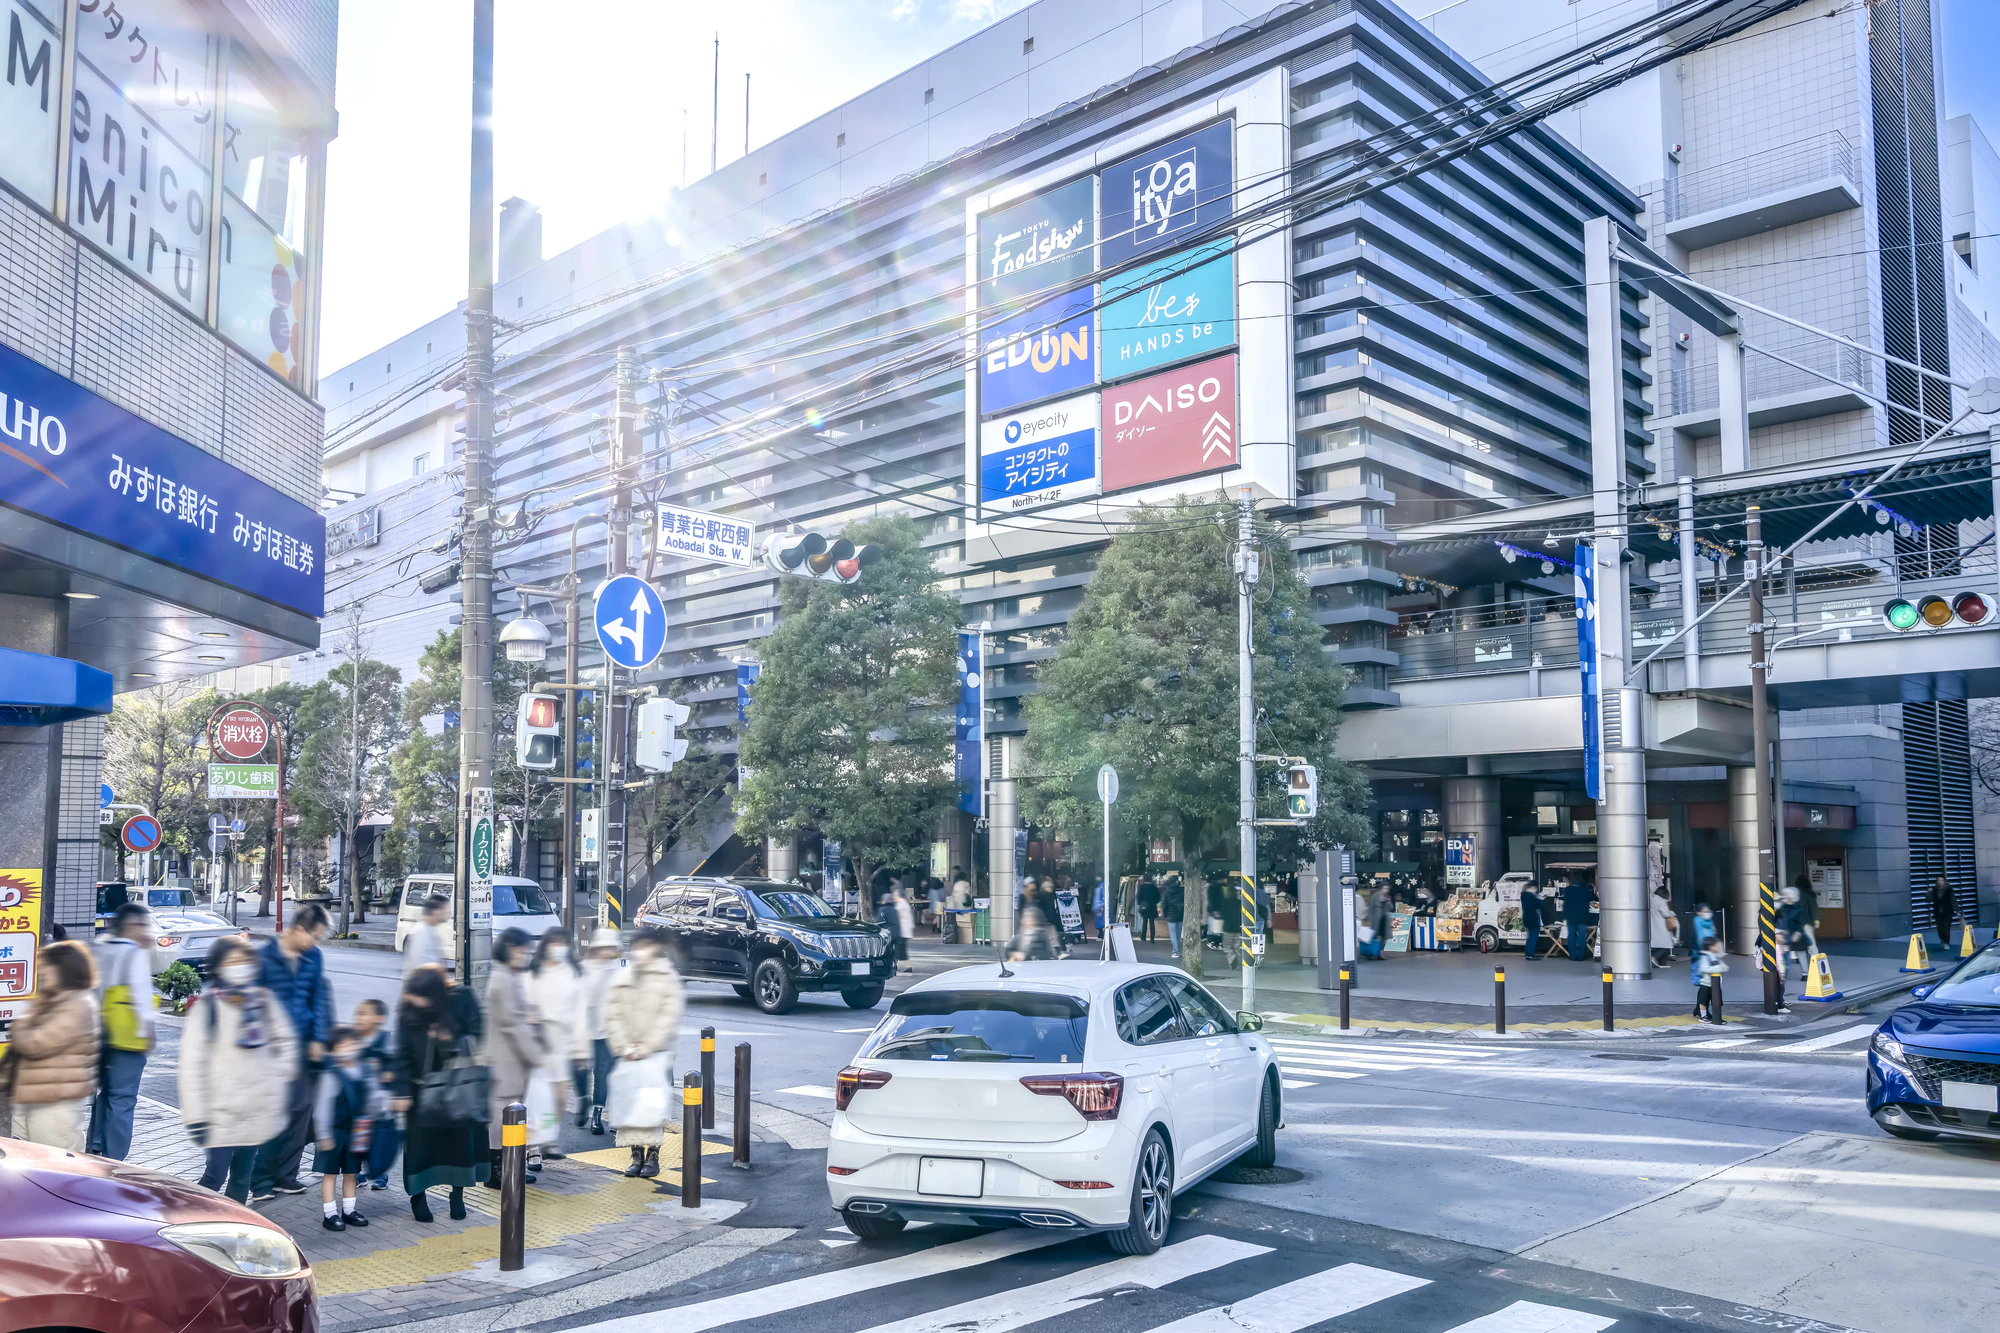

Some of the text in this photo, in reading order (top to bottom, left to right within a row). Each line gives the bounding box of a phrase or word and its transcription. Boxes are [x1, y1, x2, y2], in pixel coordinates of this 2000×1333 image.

[78, 156, 193, 303] Miru
[1022, 219, 1050, 236] TOKYU
[987, 324, 1089, 374] EDION
[1120, 323, 1213, 360] HANDS be
[1115, 377, 1221, 426] DAISO
[1023, 411, 1069, 436] eyecity
[1116, 424, 1156, 443] ダイソー
[1005, 442, 1069, 471] コンタクトの
[1005, 461, 1069, 492] アイシティ
[109, 453, 314, 576] みずほ銀行 みずほ証券
[661, 511, 750, 548] 青葉台駅西側
[664, 535, 744, 560] Aobadai Sta. W.
[223, 724, 264, 743] 消火栓
[211, 770, 275, 785] ありじ歯科
[478, 822, 490, 875] オークハウス
